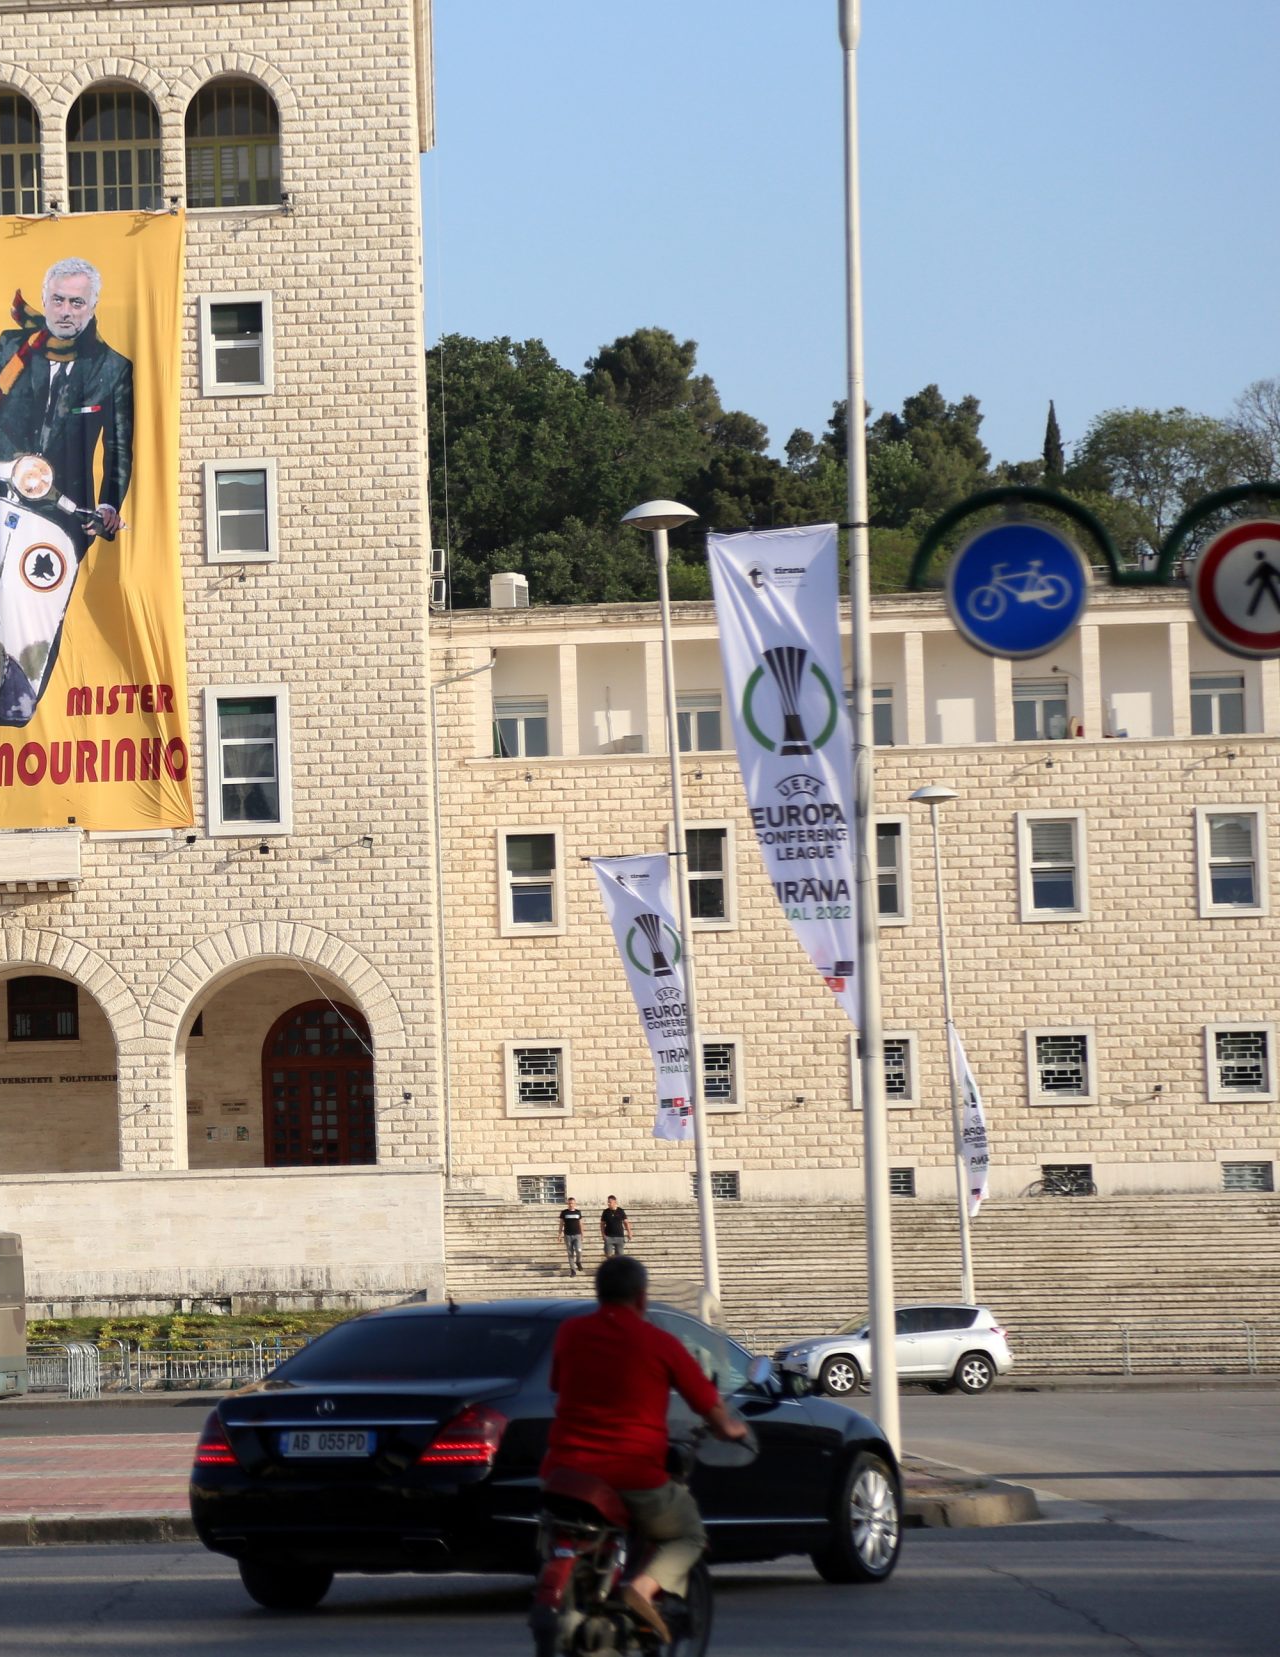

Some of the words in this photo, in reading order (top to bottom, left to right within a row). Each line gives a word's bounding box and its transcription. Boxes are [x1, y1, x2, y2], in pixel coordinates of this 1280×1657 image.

[66, 684, 174, 717] MISTER
[778, 778, 821, 797] UEFA
[750, 803, 847, 829] EUROPA
[772, 878, 851, 903] IRANA
[816, 906, 851, 919] 2022
[657, 988, 681, 1001] UEFA
[642, 1003, 688, 1021] EUROP
[647, 1018, 688, 1030] CONFERE
[662, 1029, 688, 1039] LEAGU
[293, 1434, 310, 1450] AB
